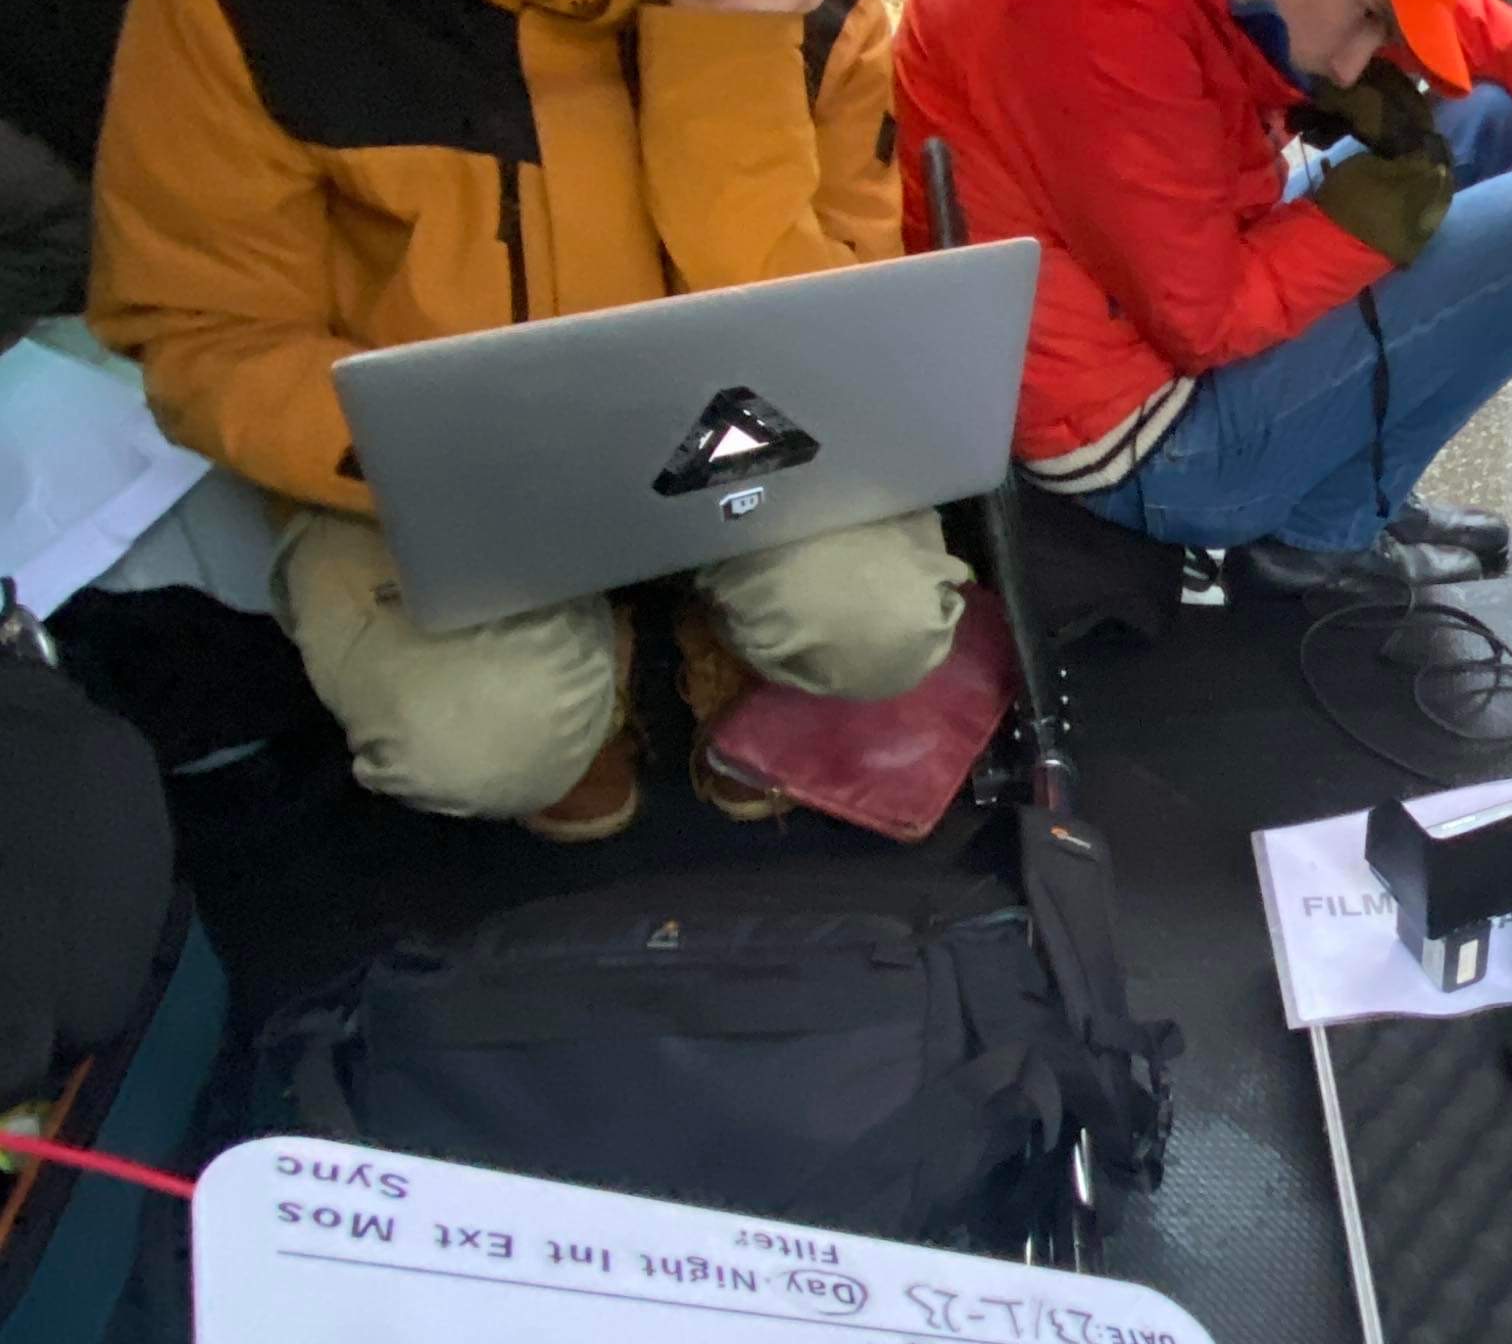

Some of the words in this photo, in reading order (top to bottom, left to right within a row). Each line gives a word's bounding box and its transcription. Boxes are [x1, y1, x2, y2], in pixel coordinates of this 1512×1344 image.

[276, 1156, 410, 1199] Sync
[277, 1201, 395, 1243] Mos
[435, 1224, 513, 1258] Ext
[549, 1240, 610, 1273] Int
[735, 1234, 839, 1265] Filter
[641, 1253, 756, 1292] Night
[787, 1271, 856, 1306] Day
